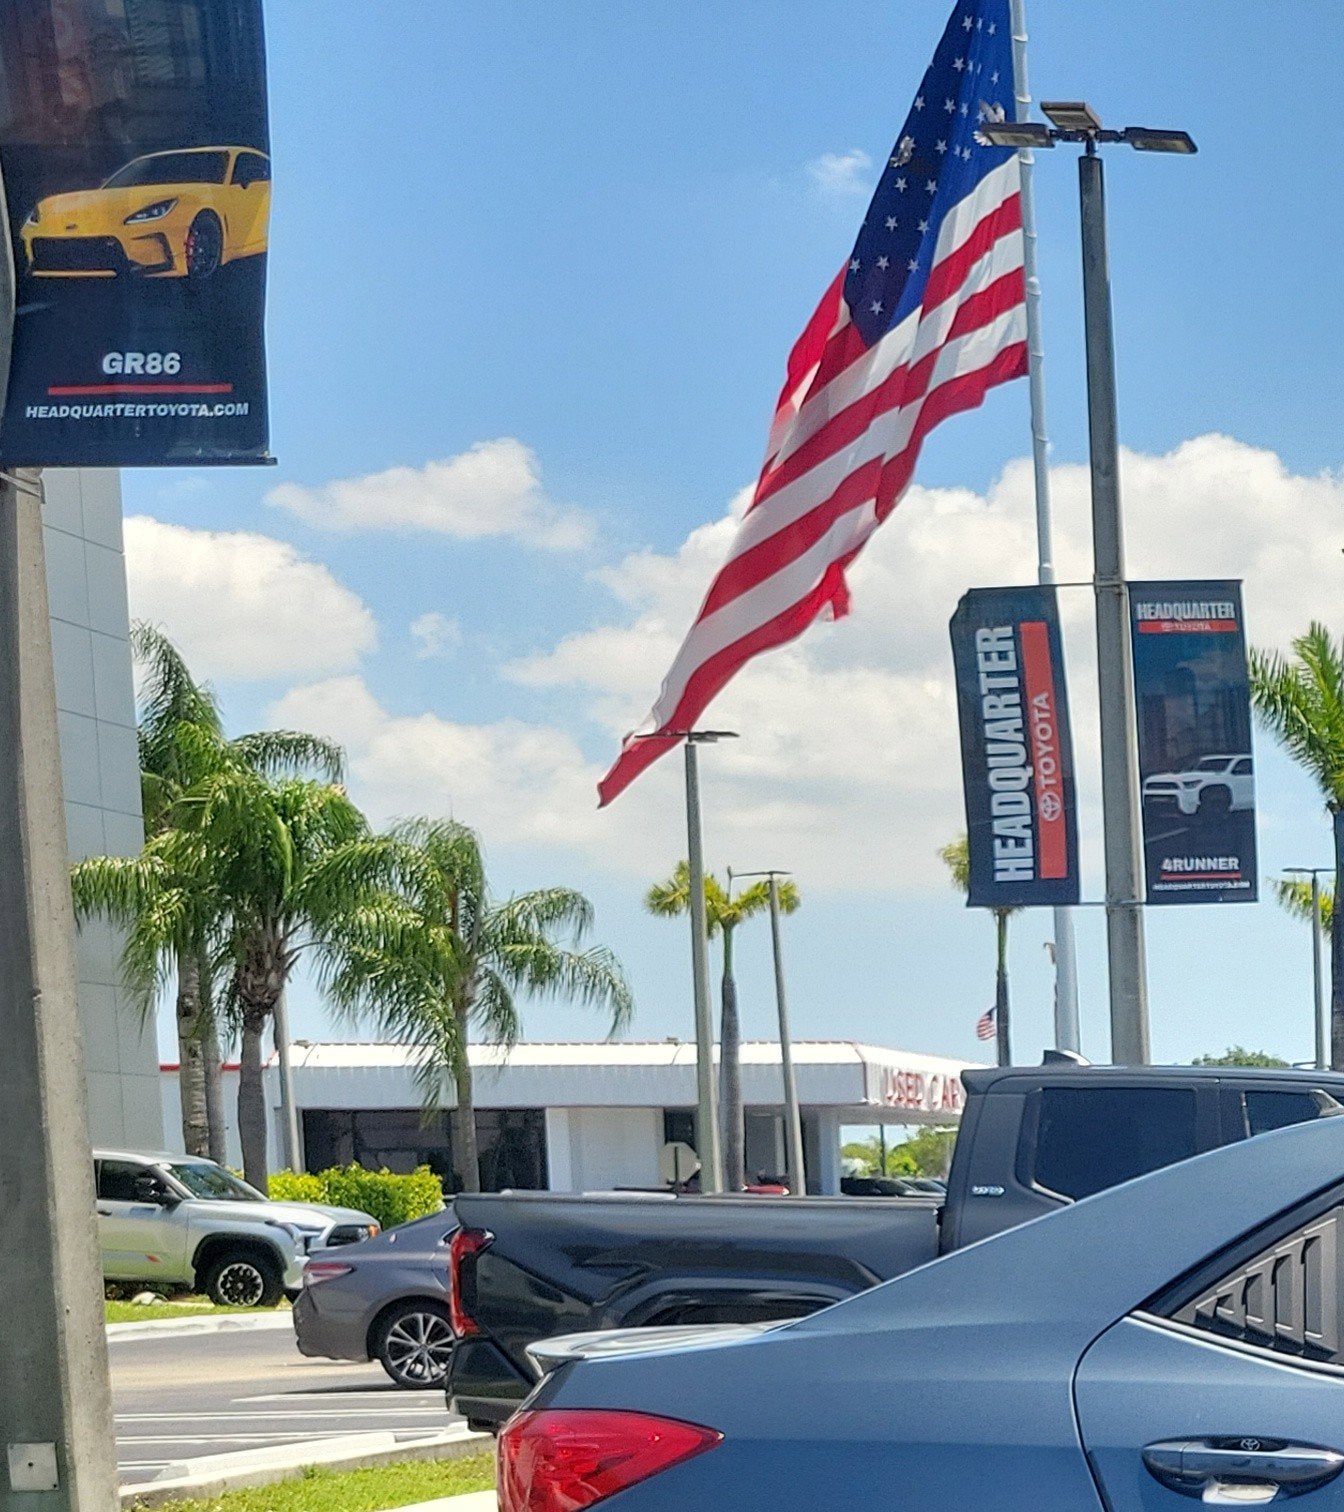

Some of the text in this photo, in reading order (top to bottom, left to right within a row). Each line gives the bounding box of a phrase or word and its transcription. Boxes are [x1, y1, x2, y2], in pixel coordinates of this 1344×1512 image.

[102, 352, 182, 376] GR86
[25, 402, 249, 420] HEADQUARTERTOYOTA.COM
[1136, 601, 1236, 621] HEADQUARTER
[1031, 692, 1057, 788] TOYOTA
[975, 625, 1035, 883] HEADQUARTER
[1162, 857, 1240, 872] 4RUNNER
[885, 1066, 963, 1111] USED CAR
